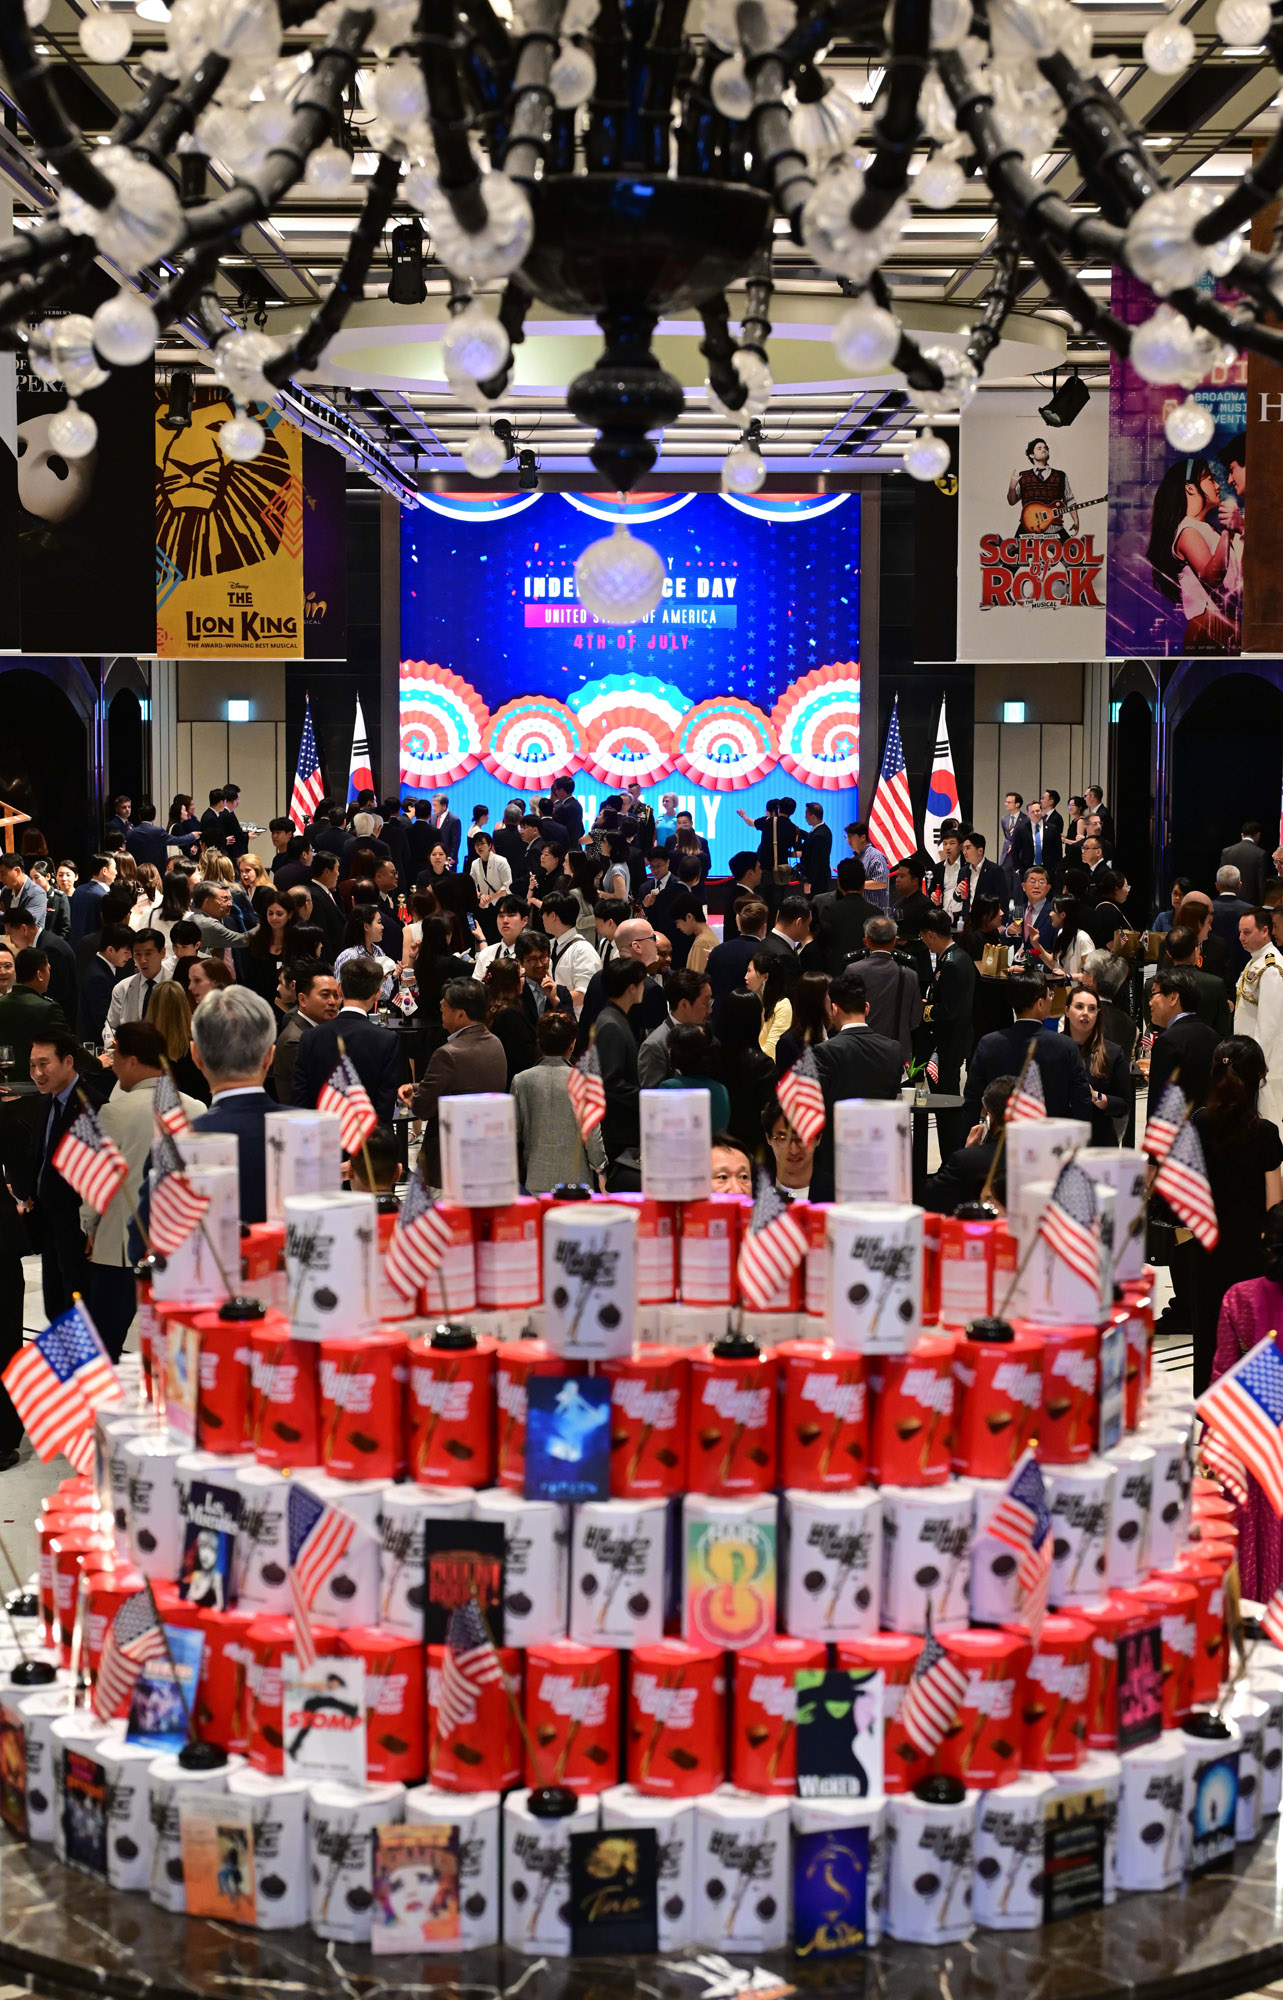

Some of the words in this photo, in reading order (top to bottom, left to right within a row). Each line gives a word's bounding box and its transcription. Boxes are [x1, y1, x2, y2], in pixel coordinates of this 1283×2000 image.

[980, 533, 1104, 565] SCHOOL
[1029, 559, 1054, 583] of
[228, 581, 249, 590] Disney
[697, 577, 738, 598] DAY
[980, 566, 1105, 609] ROCK
[227, 592, 254, 604] THE
[186, 611, 234, 641] LION
[241, 611, 298, 642] KING
[544, 608, 588, 624] UNITED
[662, 609, 717, 624] AMERICA
[573, 634, 606, 650] 4TH
[617, 634, 637, 650] OF
[647, 634, 689, 650] JULY
[288, 1711, 363, 1732] STOMP
